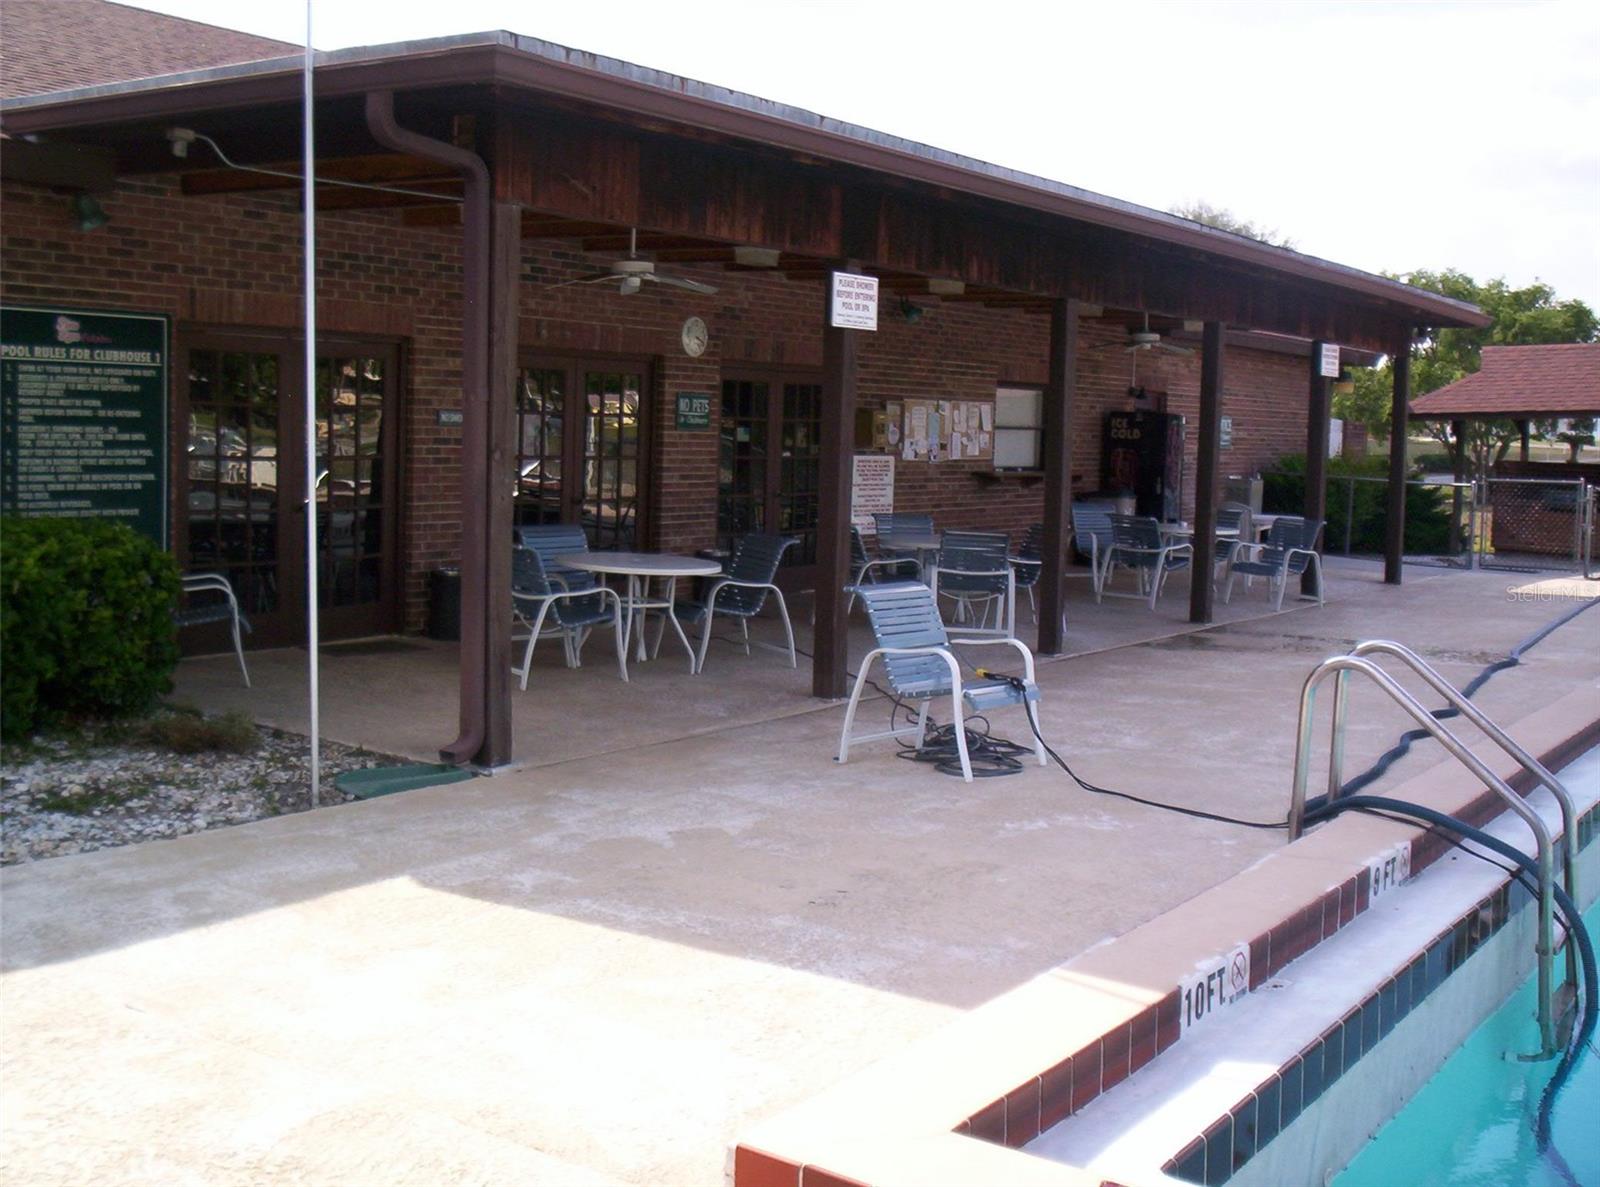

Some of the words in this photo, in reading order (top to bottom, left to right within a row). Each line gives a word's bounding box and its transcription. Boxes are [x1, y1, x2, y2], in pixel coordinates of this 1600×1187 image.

[1, 345, 31, 357] POOL
[34, 346, 67, 360] RULES
[70, 349, 91, 361] FOR
[94, 350, 153, 363] CLUBHOUSE
[155, 352, 161, 363] 1
[692, 399, 710, 413] PETS
[1111, 418, 1128, 428] ICE
[1111, 428, 1141, 439] COLD
[1373, 866, 1380, 897] 9
